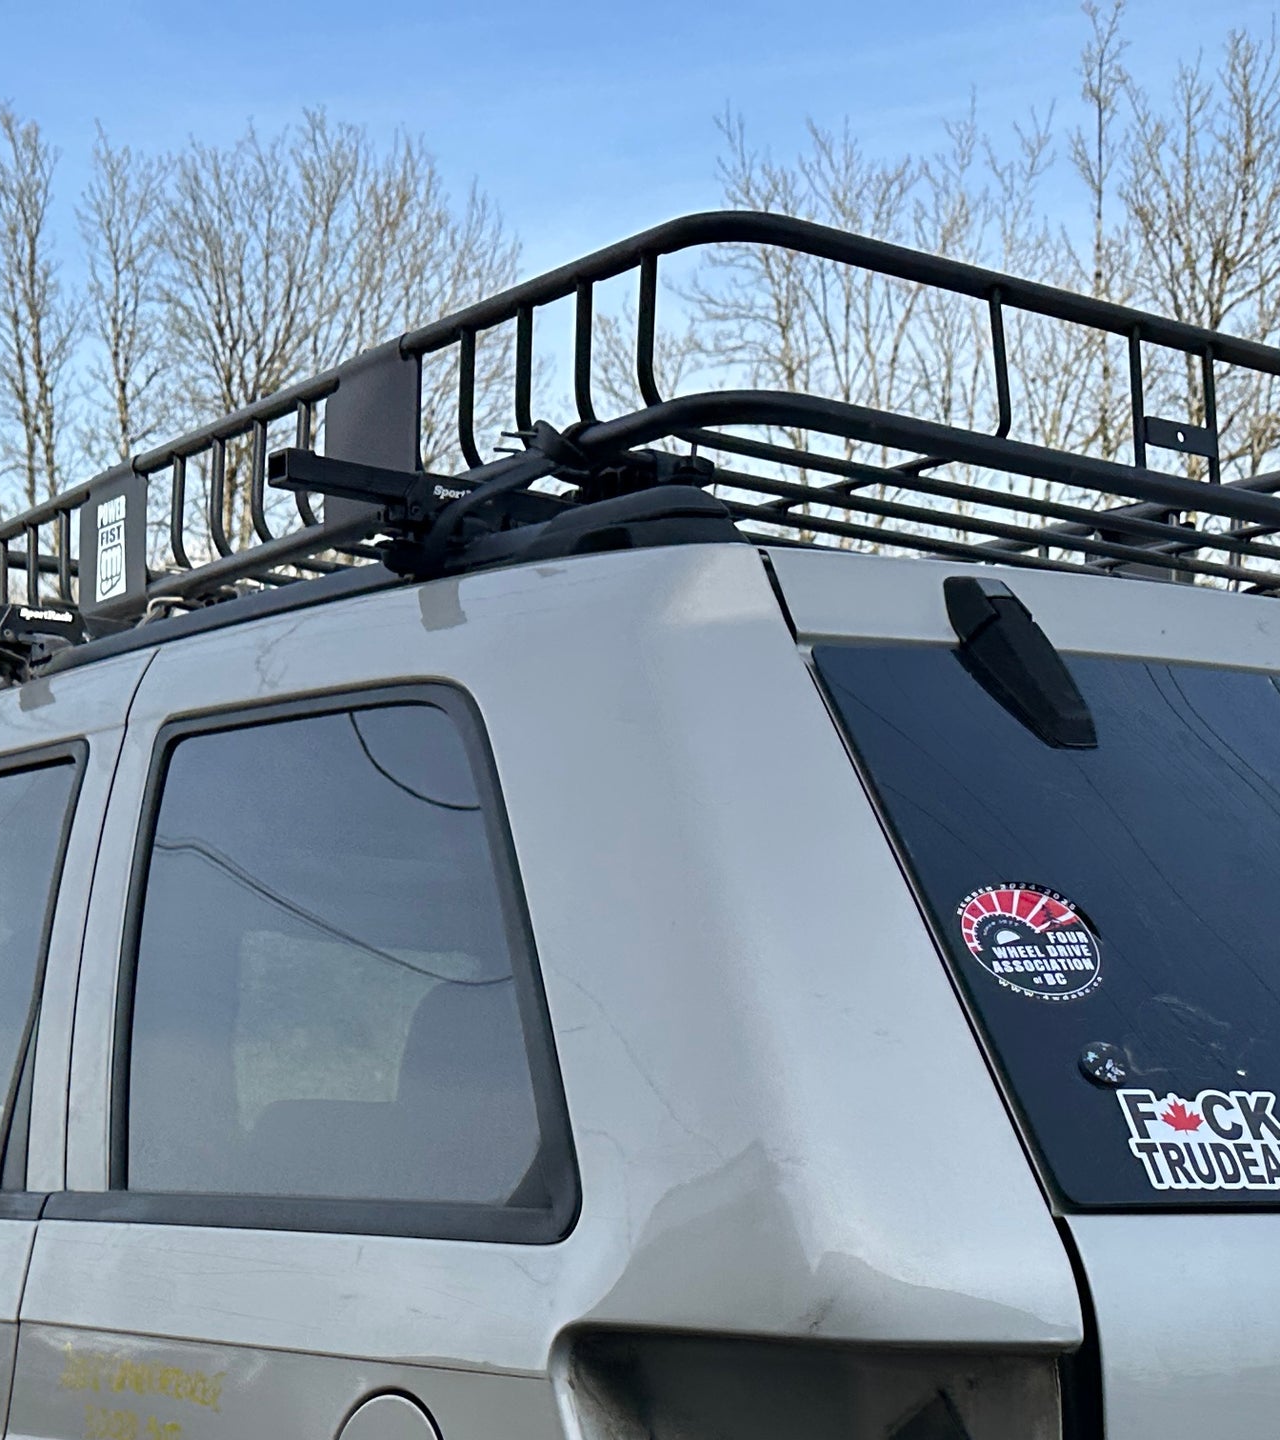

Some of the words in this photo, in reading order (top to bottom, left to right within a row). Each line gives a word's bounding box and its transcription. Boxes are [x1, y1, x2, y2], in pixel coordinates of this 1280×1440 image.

[101, 525, 122, 547] FIST
[1046, 931, 1089, 944] FOUR
[992, 945, 1045, 959] WHEEL
[1045, 944, 1092, 958] DRIVE
[992, 958, 1095, 973] ASSOCIATION
[1032, 975, 1043, 985] of
[1043, 973, 1067, 986] BC
